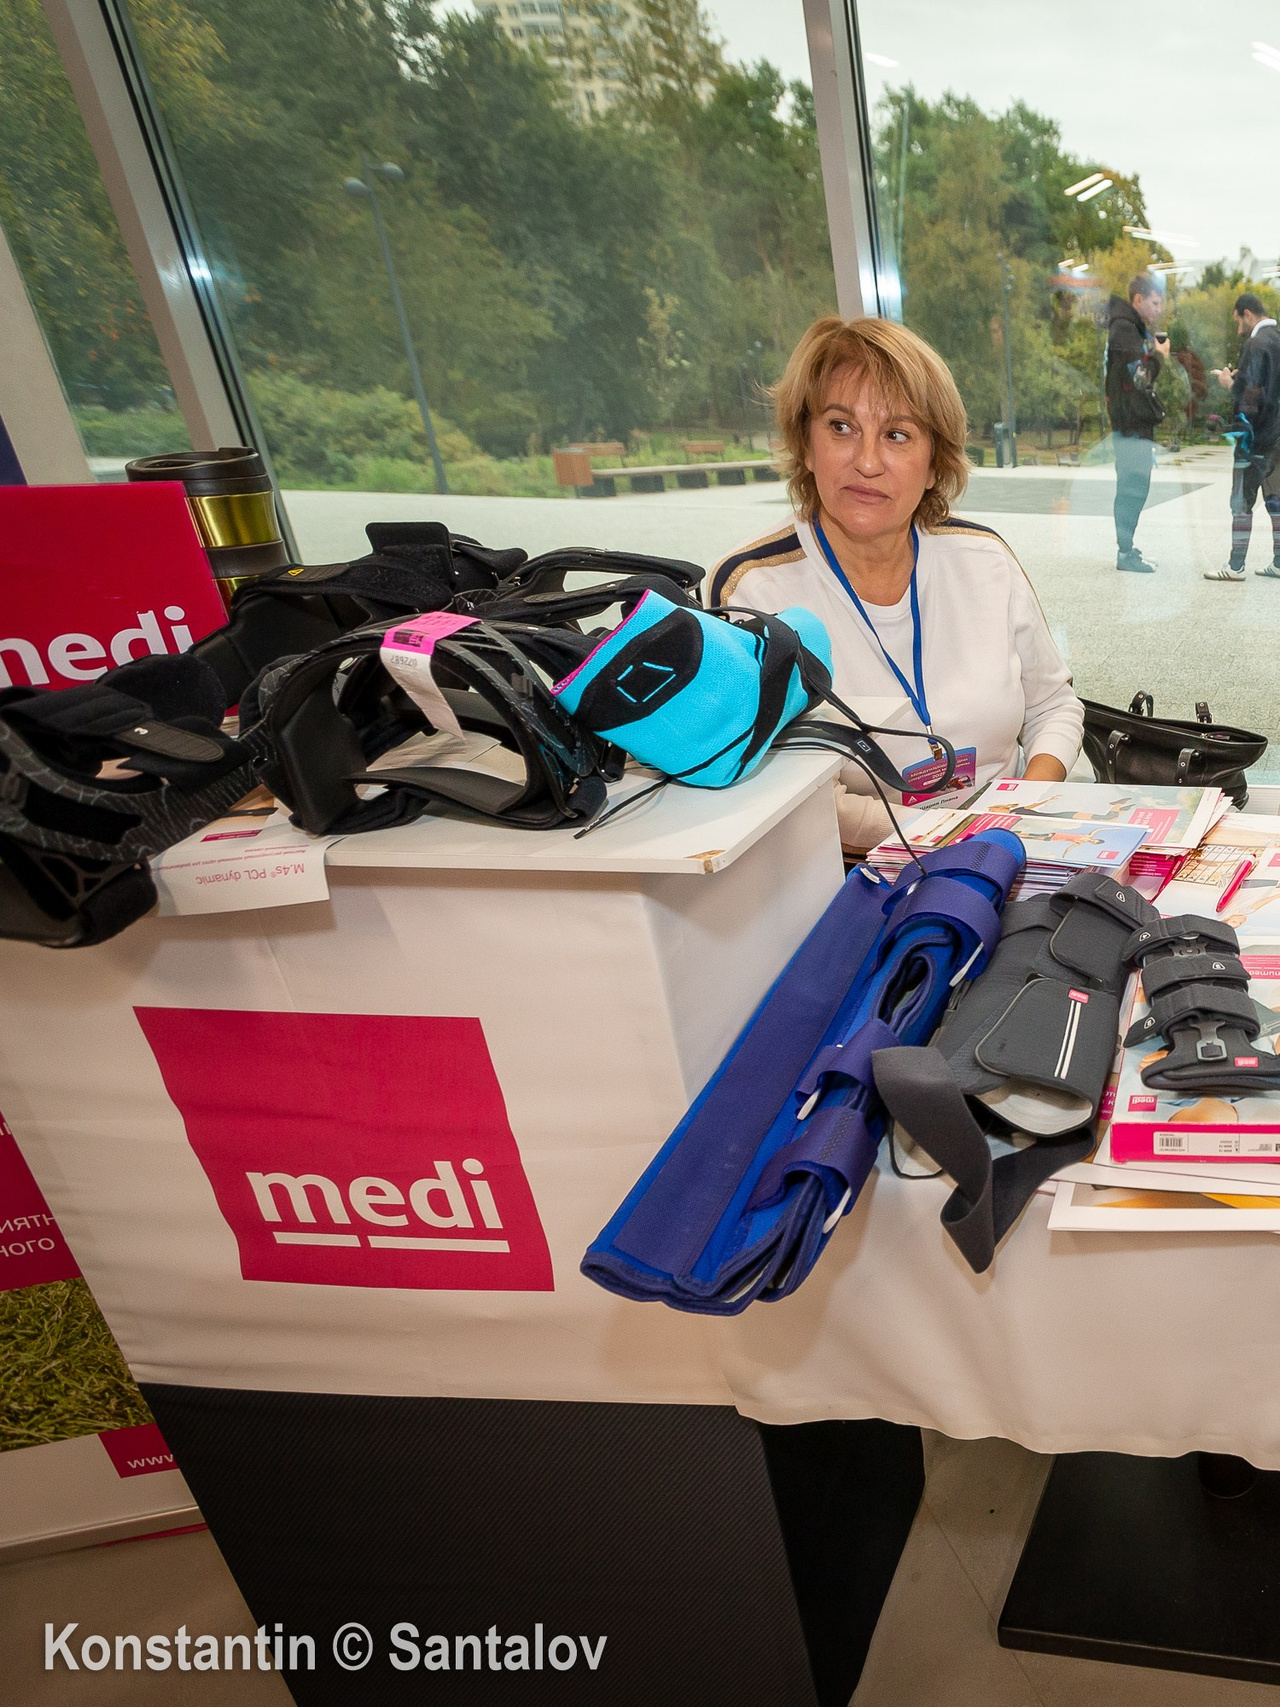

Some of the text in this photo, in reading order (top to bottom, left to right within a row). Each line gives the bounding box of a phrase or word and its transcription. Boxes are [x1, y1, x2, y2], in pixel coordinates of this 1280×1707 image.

[195, 870, 241, 886] dynamic
[244, 868, 267, 882] PCL
[1131, 1095, 1155, 1105] medi
[245, 1158, 506, 1230] medi
